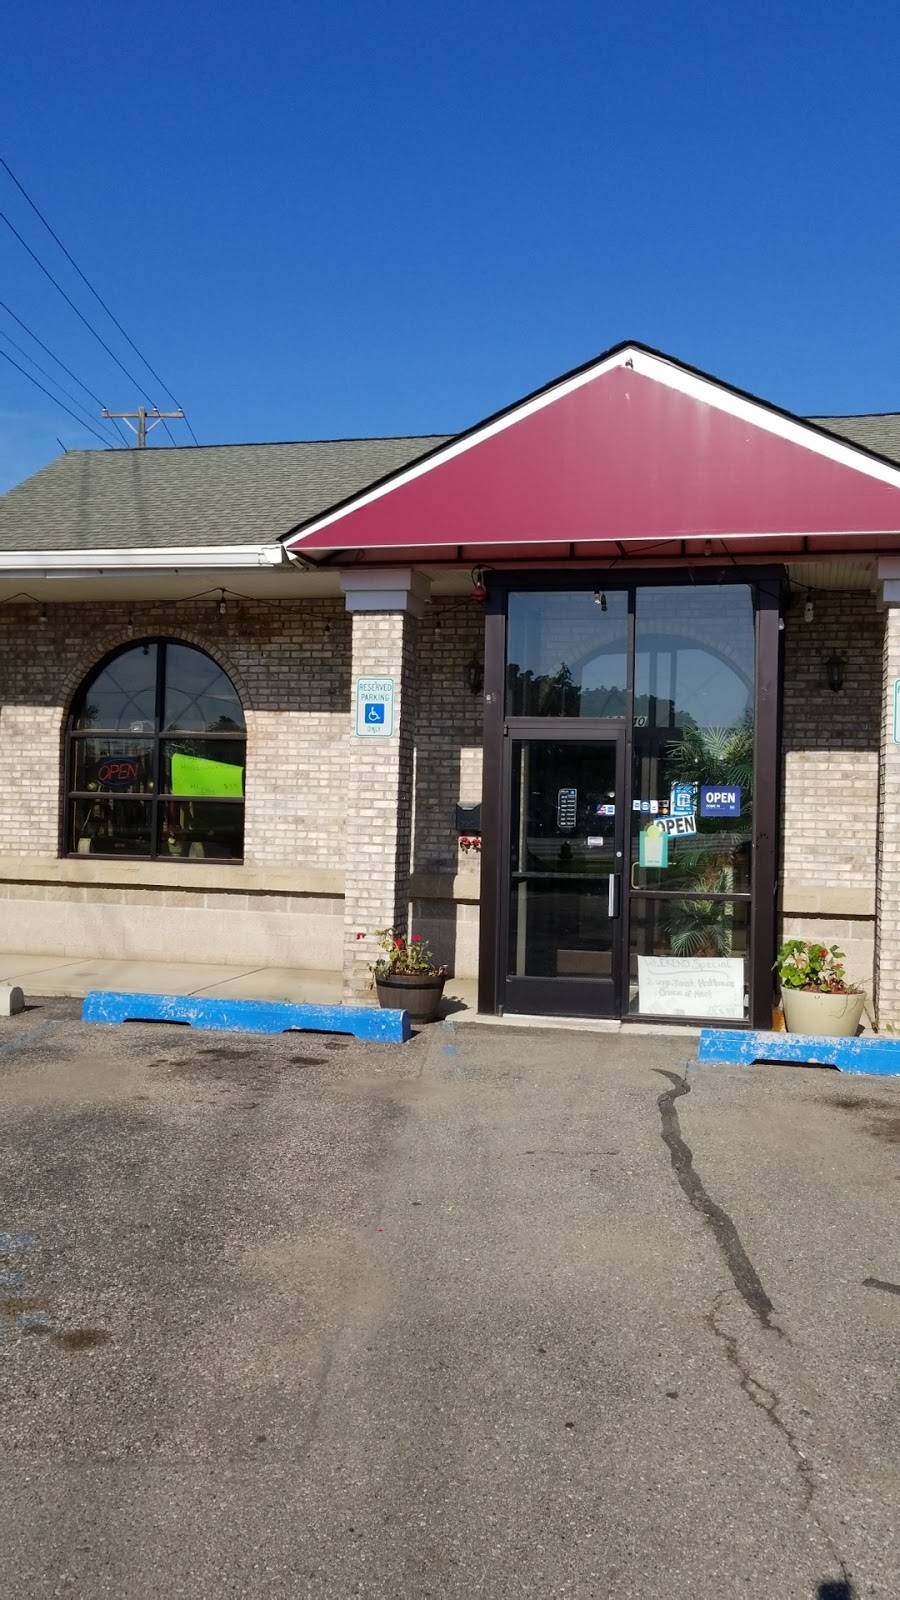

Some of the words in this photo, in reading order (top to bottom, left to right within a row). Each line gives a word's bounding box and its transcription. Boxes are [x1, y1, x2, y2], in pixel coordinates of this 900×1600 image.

[359, 683, 392, 692] RESERVED
[361, 693, 391, 702] PARKING
[98, 763, 139, 782] OPEN
[705, 792, 736, 804] OPEN
[656, 816, 695, 835] OPEN
